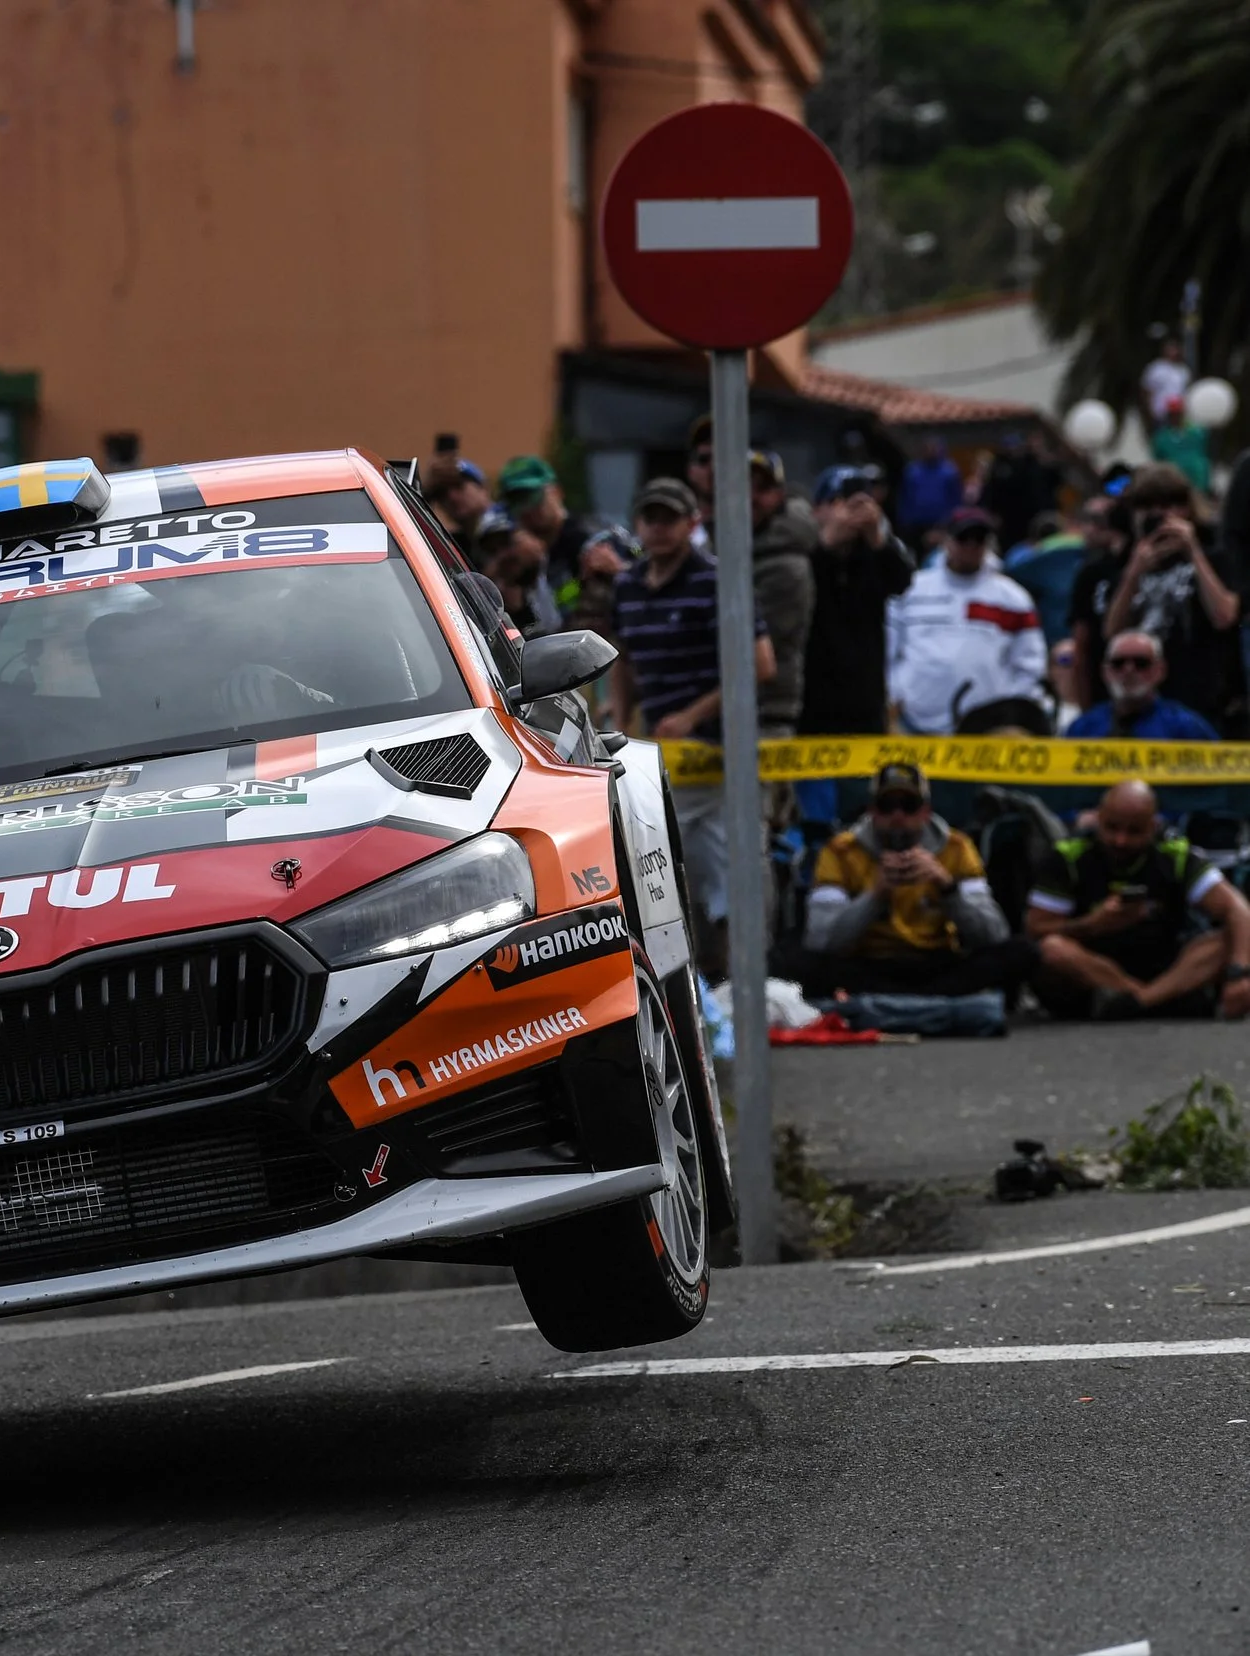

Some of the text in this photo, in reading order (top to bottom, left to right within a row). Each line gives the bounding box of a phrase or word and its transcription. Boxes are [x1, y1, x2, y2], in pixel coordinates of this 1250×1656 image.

[428, 1006, 589, 1083] HYRMASKINER
[3, 1130, 16, 1144] S
[23, 1123, 58, 1140] 109
